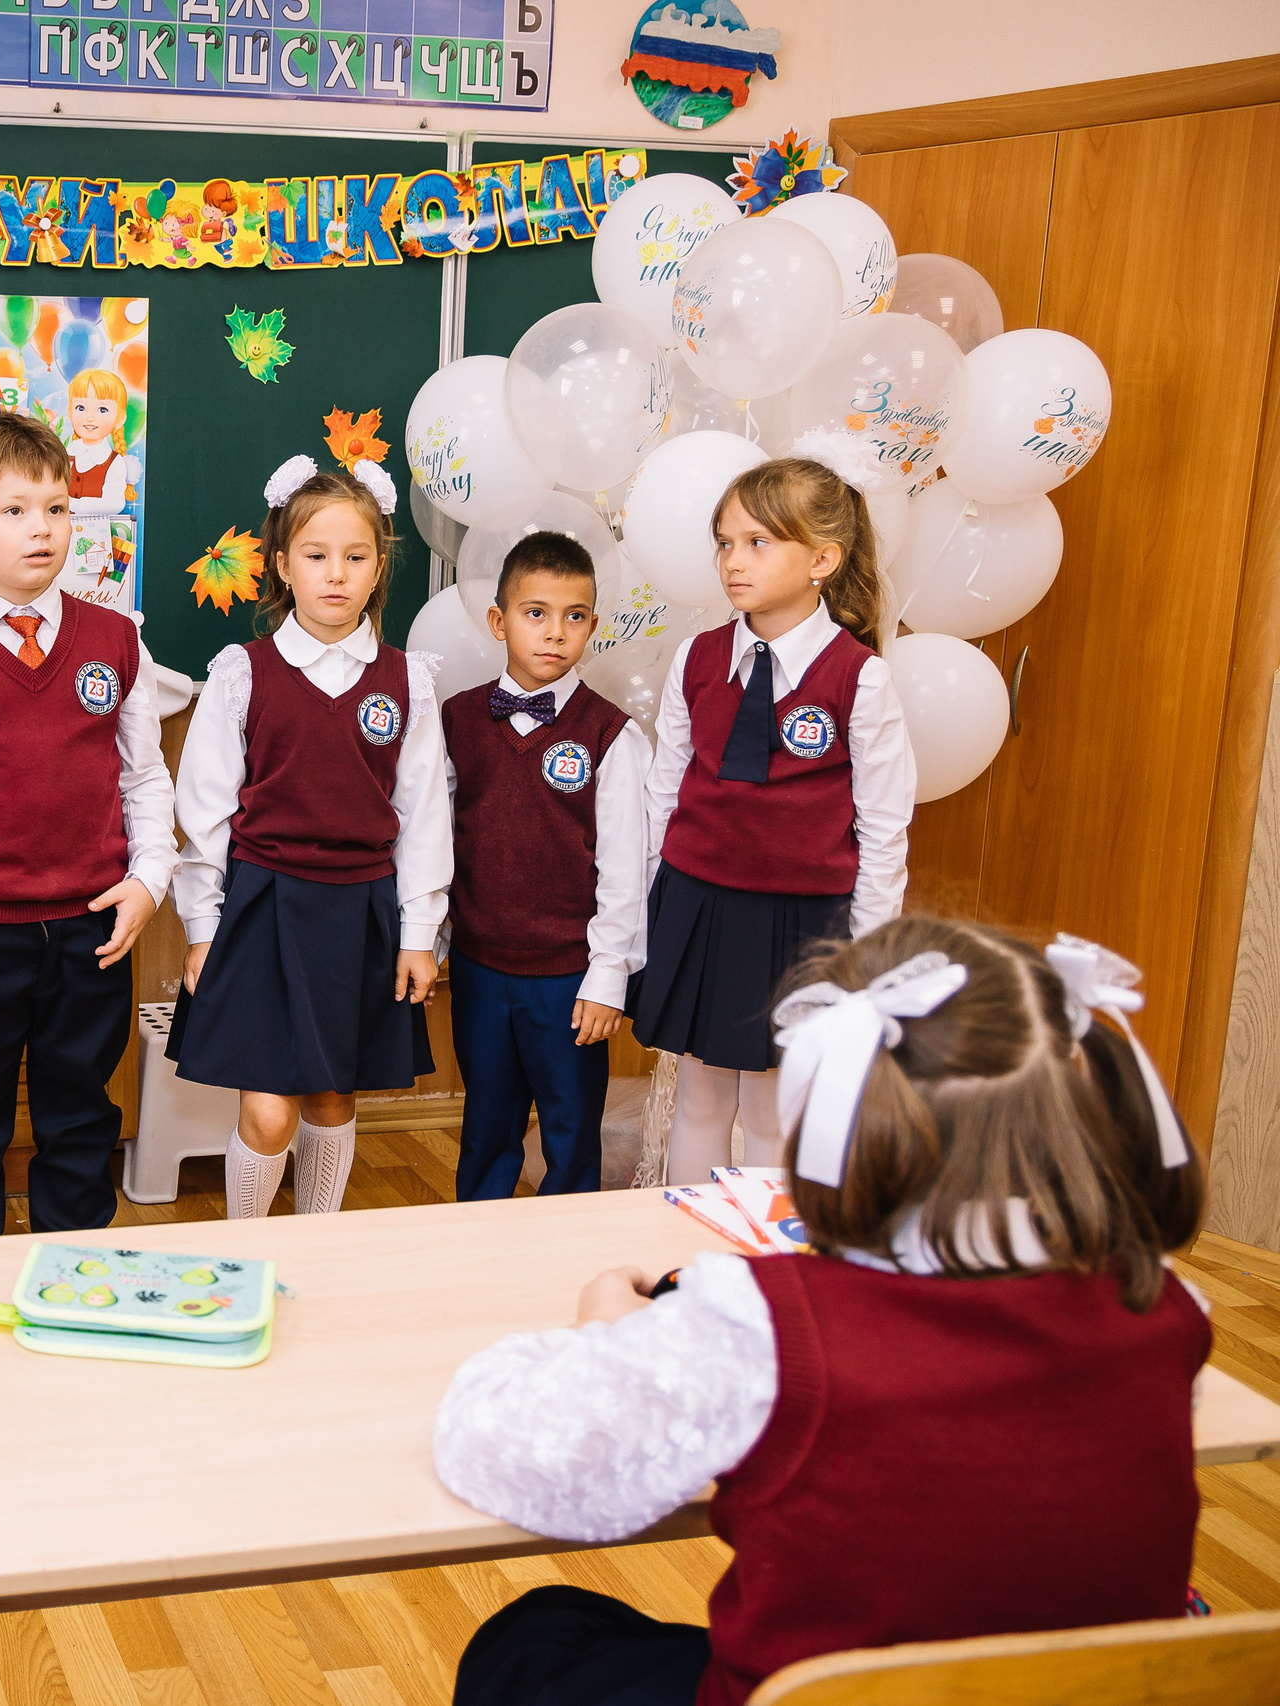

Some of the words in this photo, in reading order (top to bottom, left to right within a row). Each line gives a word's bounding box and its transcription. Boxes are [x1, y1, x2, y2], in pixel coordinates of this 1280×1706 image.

[264, 149, 610, 268] ШКОЛА!
[89, 681, 105, 697] 23
[371, 710, 388, 727] 23
[797, 724, 819, 740] 23
[557, 760, 577, 775] 23
